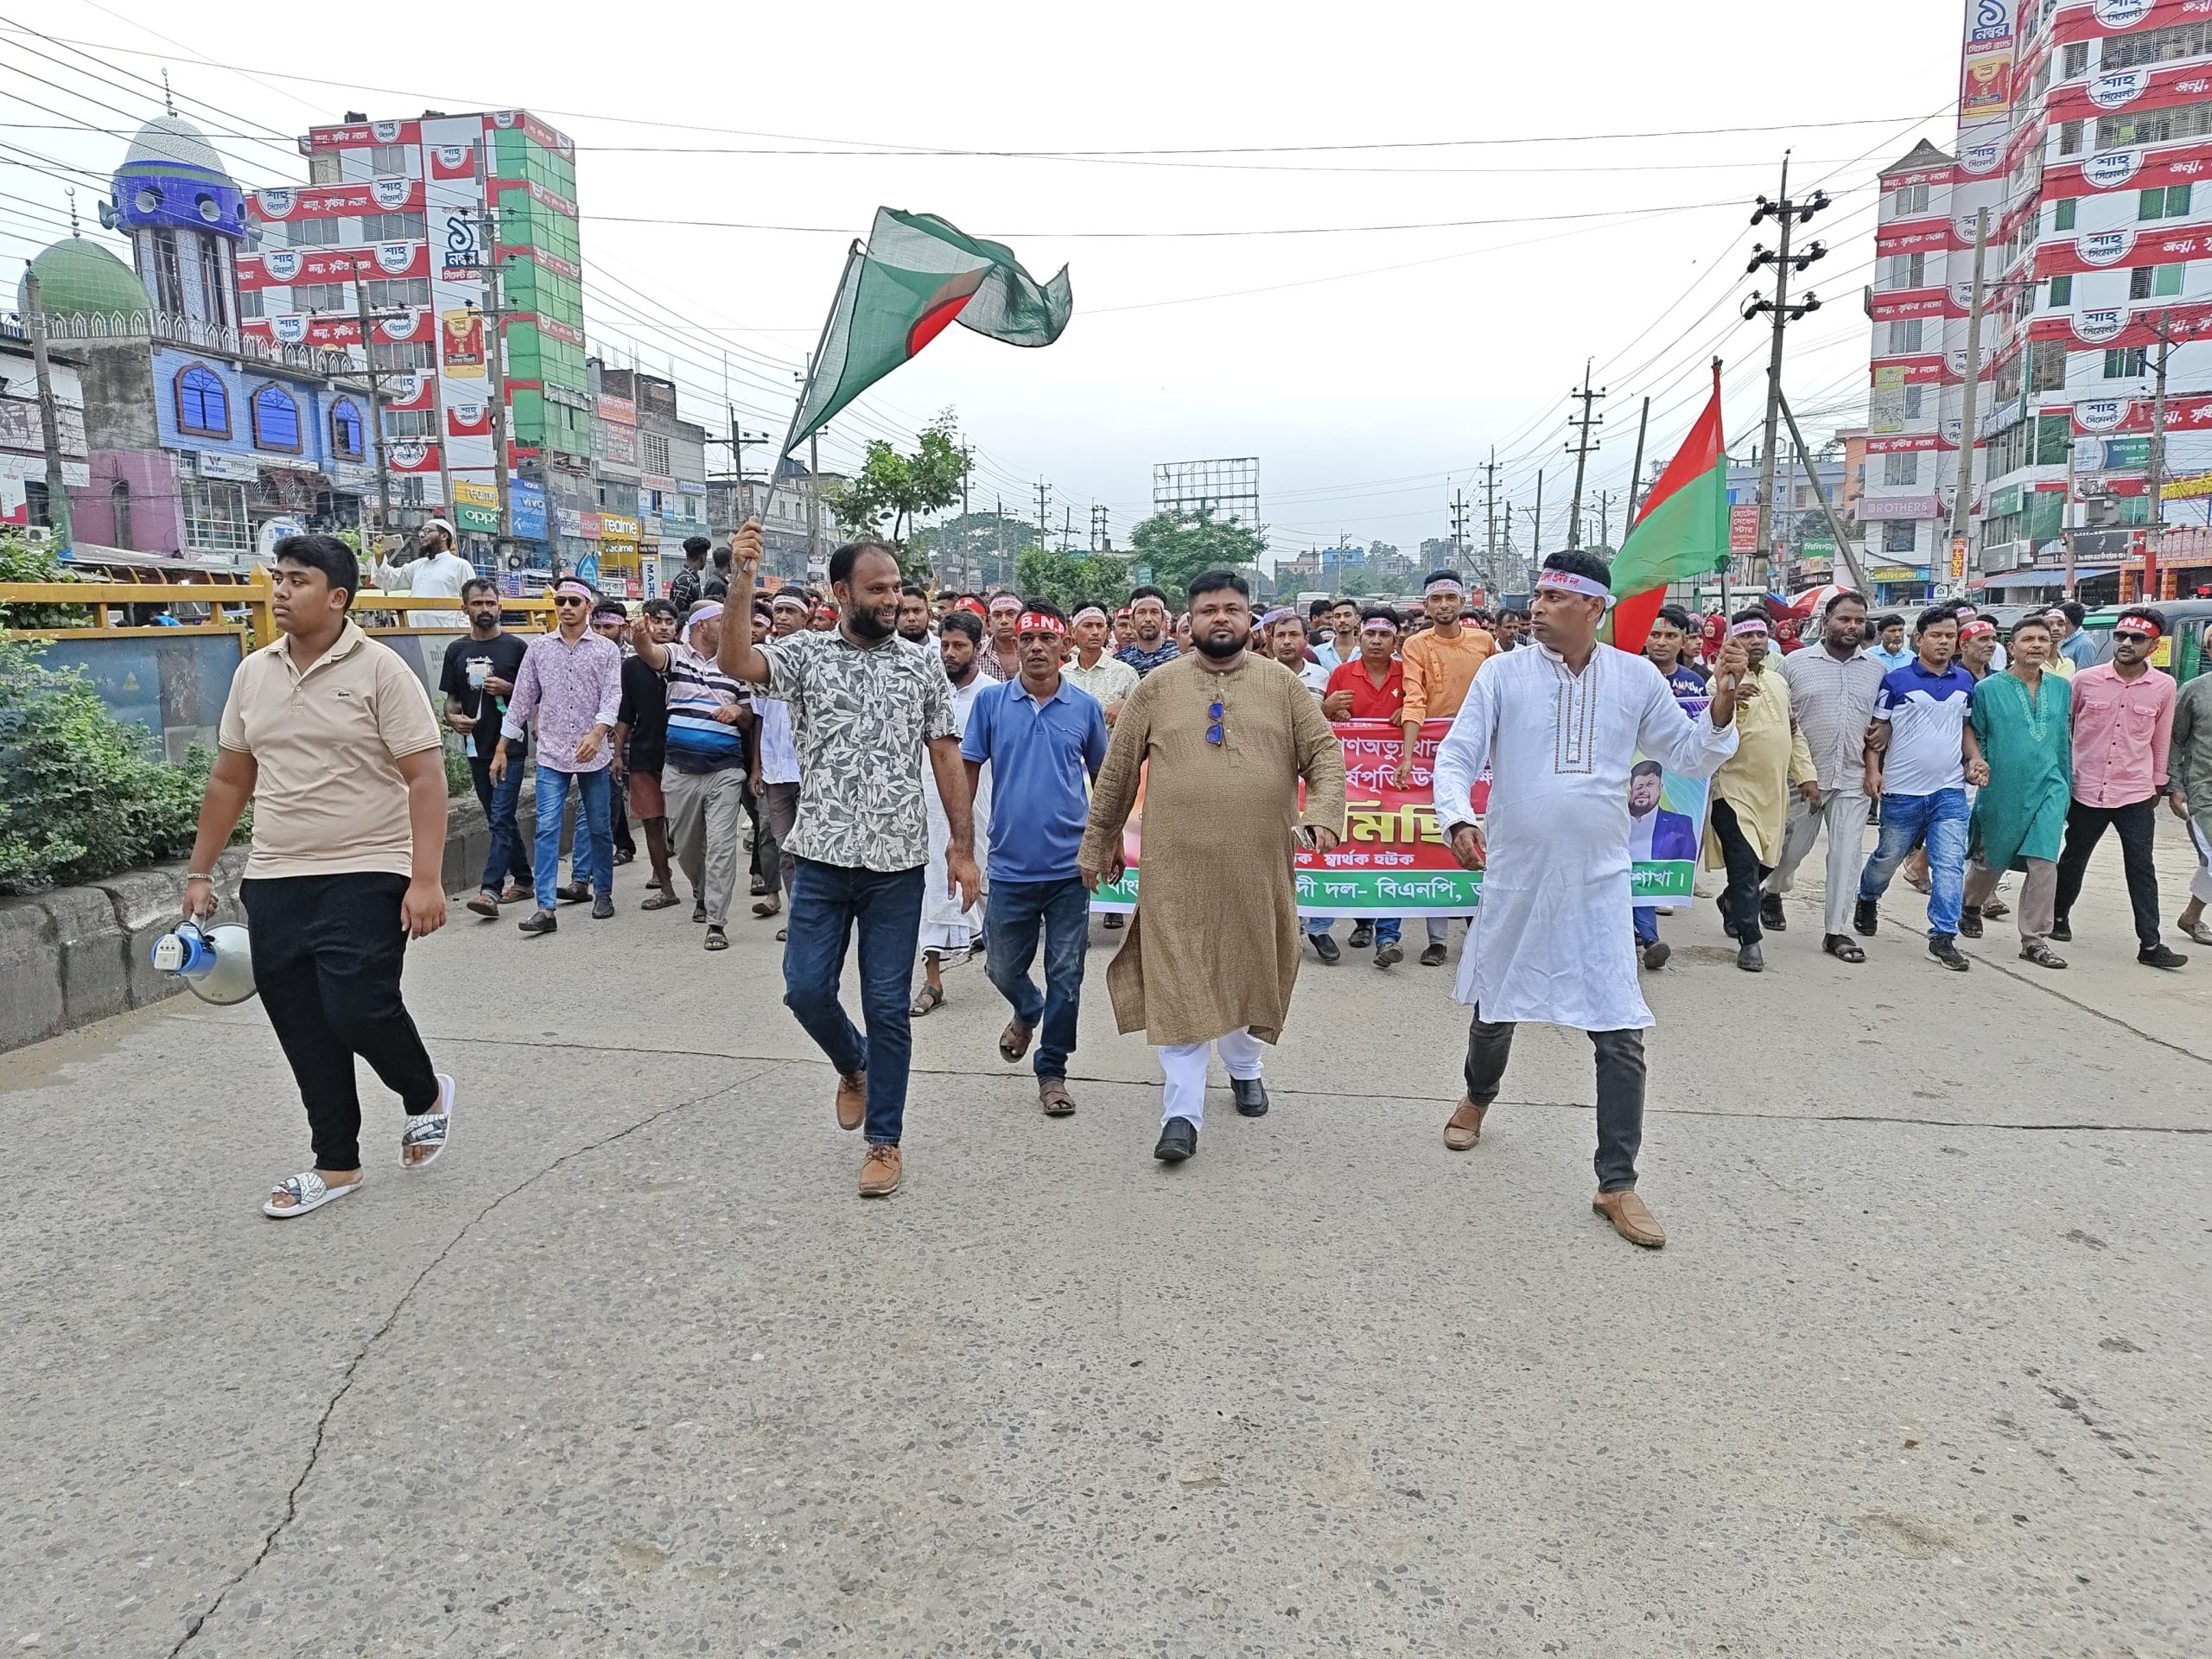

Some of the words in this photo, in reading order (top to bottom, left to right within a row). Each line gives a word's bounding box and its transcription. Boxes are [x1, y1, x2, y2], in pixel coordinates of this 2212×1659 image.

[2170, 161, 2203, 173] জন্ম,
[2096, 168, 2131, 181] সিমেন্ট
[2089, 245, 2124, 258] সিমেন্ট
[2164, 240, 2196, 252] জন্ম,
[2084, 326, 2118, 337] সিমেন্ট
[2087, 414, 2119, 425] সিমেন্ট
[205, 465, 227, 474] WALTON
[524, 481, 539, 490] NOKIA
[524, 496, 545, 508] vivo
[1868, 502, 1928, 512] BROTHERS
[606, 518, 638, 534] realme
[606, 543, 634, 552] realme
[1569, 577, 1580, 588] দল
[1373, 850, 1415, 866] হউক
